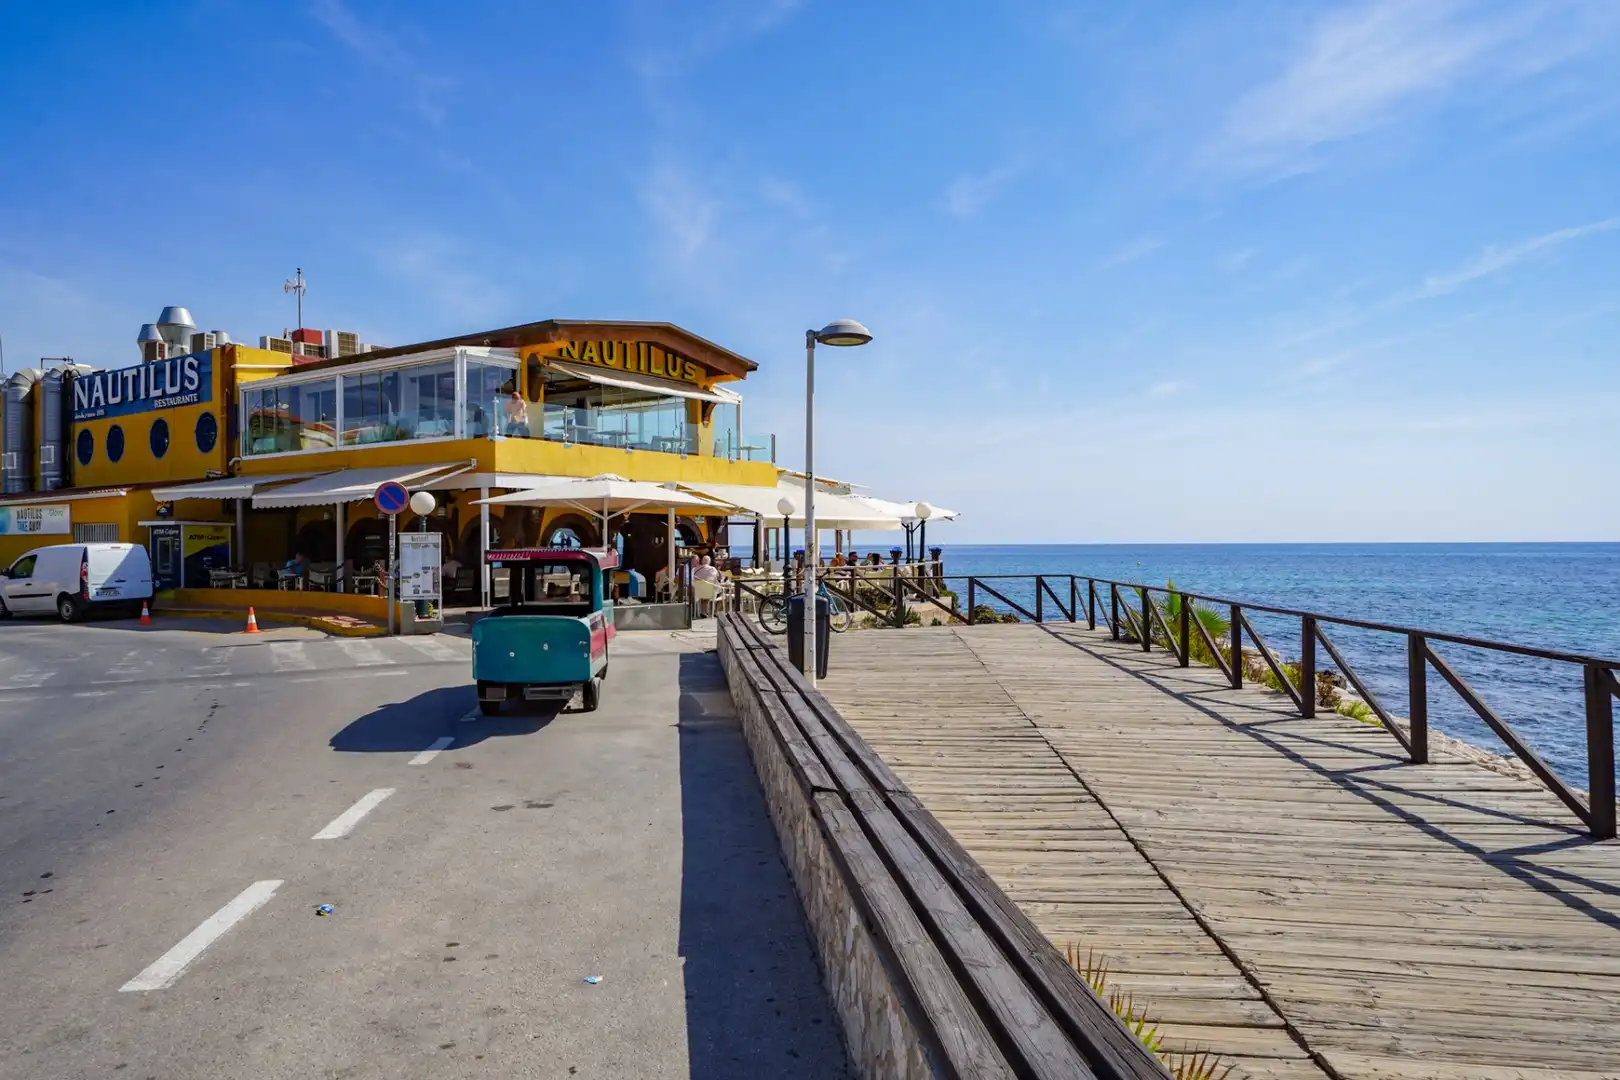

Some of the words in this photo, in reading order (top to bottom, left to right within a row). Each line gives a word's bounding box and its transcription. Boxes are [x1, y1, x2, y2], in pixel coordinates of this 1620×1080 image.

[562, 340, 697, 379] NAUTILUS
[74, 356, 199, 411] NAUTILUS
[154, 393, 199, 408] RESTAURANTE
[16, 508, 43, 520] NAUTILUS
